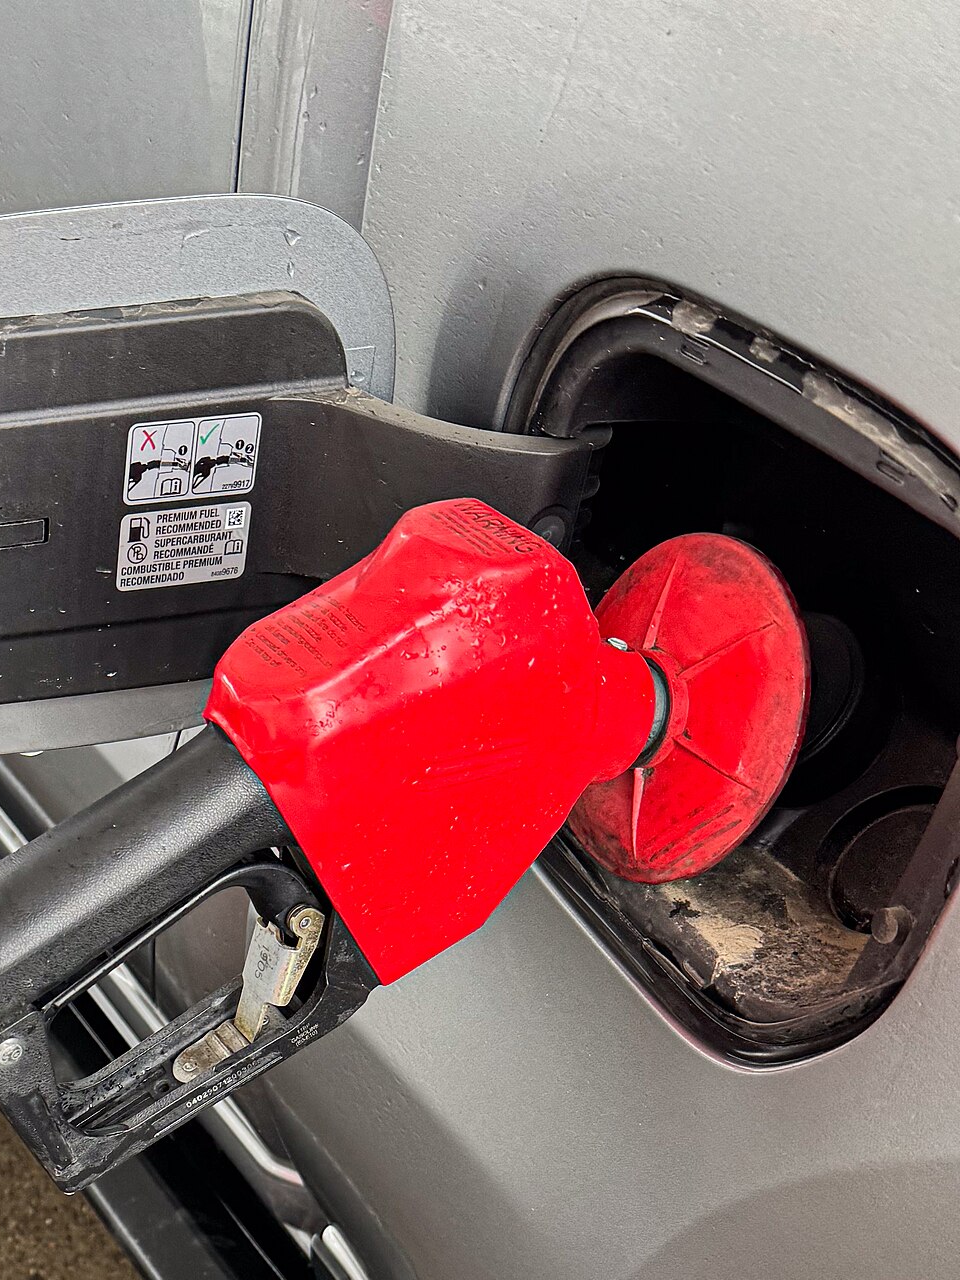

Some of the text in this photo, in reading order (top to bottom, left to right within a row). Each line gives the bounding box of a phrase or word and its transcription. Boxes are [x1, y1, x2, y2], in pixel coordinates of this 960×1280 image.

[156, 508, 220, 524] PREMIUM FUEL
[155, 519, 222, 536] RECOMMENDED
[154, 531, 233, 548] SUPERCARBURANT
[153, 543, 214, 560] RECOMMANDÉ
[121, 556, 223, 576] COMBUSTIBLE PREMIUM
[120, 571, 185, 588] RECOMENDADO
